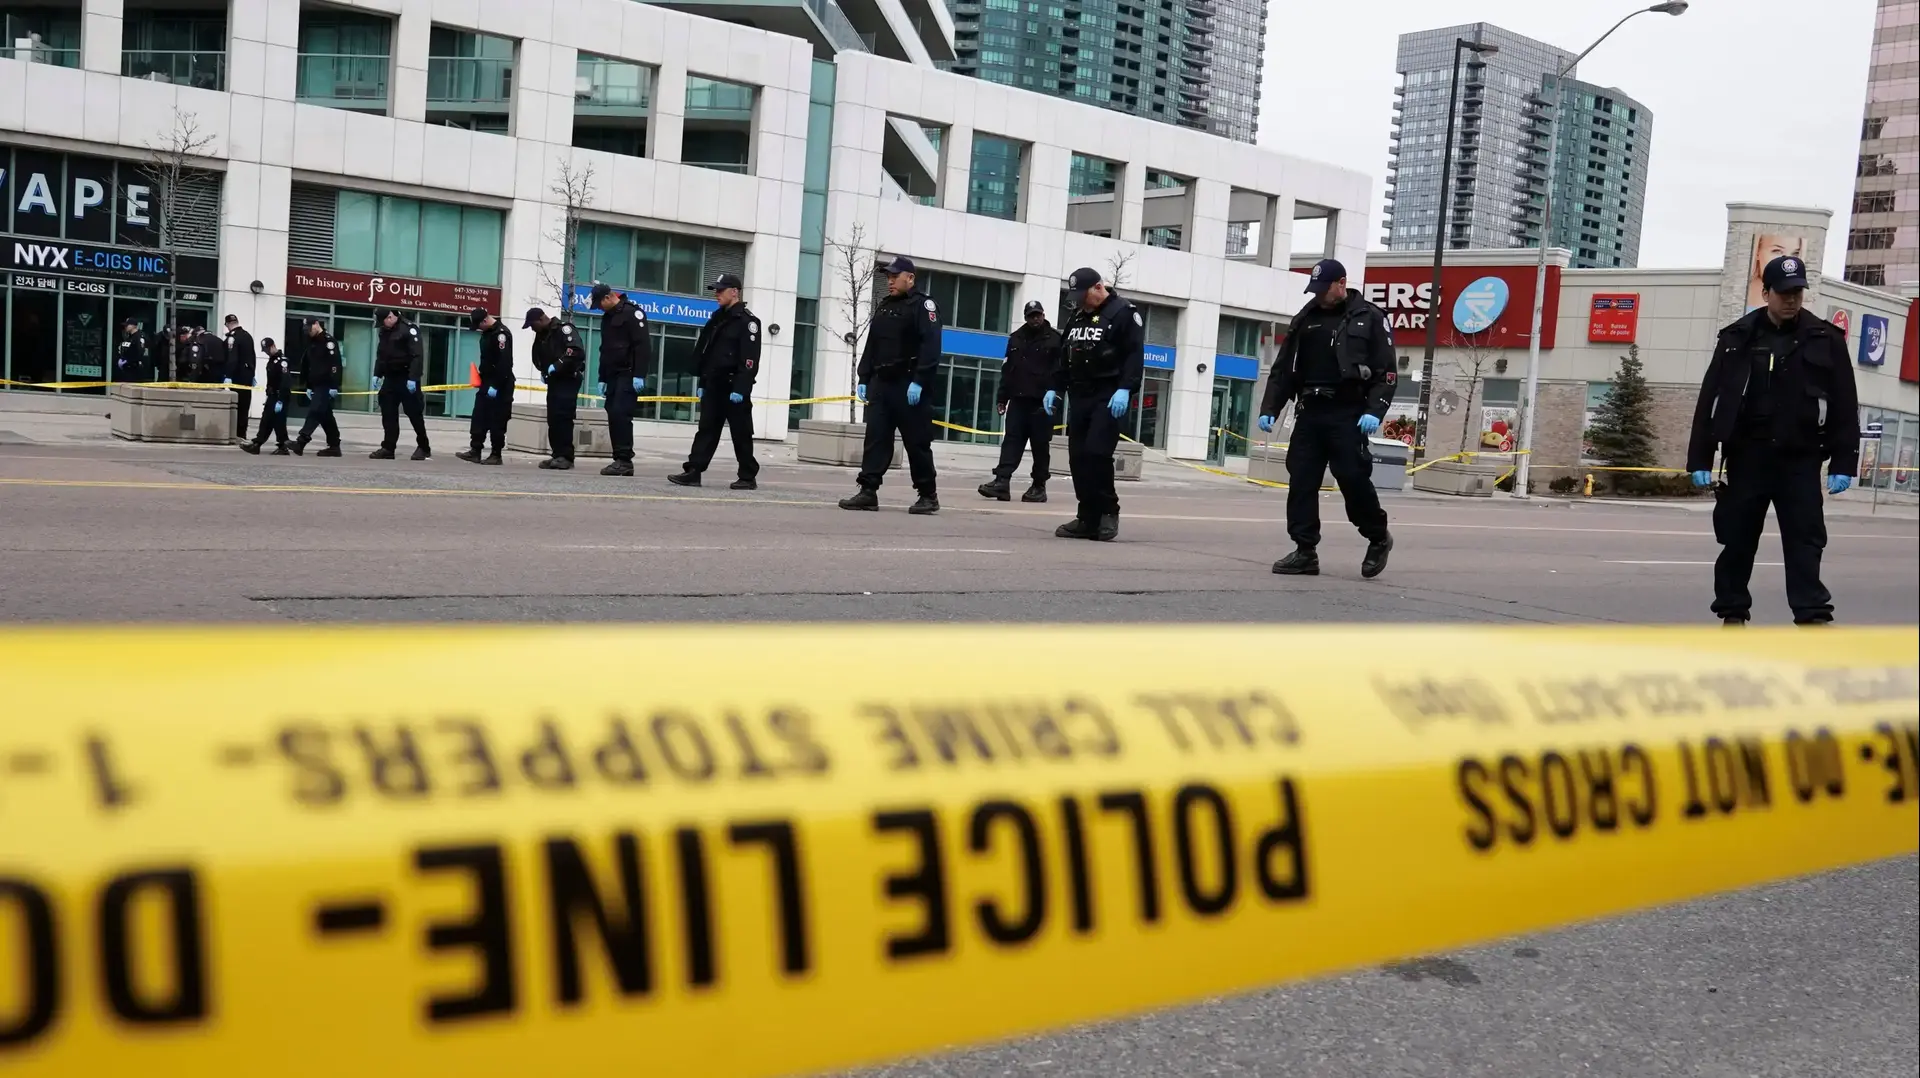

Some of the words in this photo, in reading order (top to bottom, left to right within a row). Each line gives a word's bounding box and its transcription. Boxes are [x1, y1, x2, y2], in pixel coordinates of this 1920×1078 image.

[0, 169, 150, 226] APE
[14, 243, 69, 269] NYX
[74, 250, 132, 270] E-CIGS
[138, 256, 168, 274] INC.
[15, 276, 35, 288] 전자
[37, 278, 57, 289] 담배
[67, 281, 106, 293] E-CIGS
[295, 275, 310, 286] The
[317, 277, 351, 291] history
[353, 282, 365, 291] of
[404, 284, 422, 297] HUI
[433, 302, 458, 310] Wellbeing
[1364, 282, 1442, 309] ERS
[662, 303, 673, 314] of
[677, 305, 713, 319] Montr
[1068, 327, 1103, 340] POLICE
[1868, 327, 1880, 336] OPEN
[1871, 336, 1880, 346] 24
[1144, 353, 1168, 362] ntreal
[1135, 689, 1303, 753] CALL
[856, 697, 1123, 769] CRIME
[1676, 735, 1772, 815] NOT
[1456, 743, 1658, 850] CROSS
[871, 775, 1314, 961] POLICE
